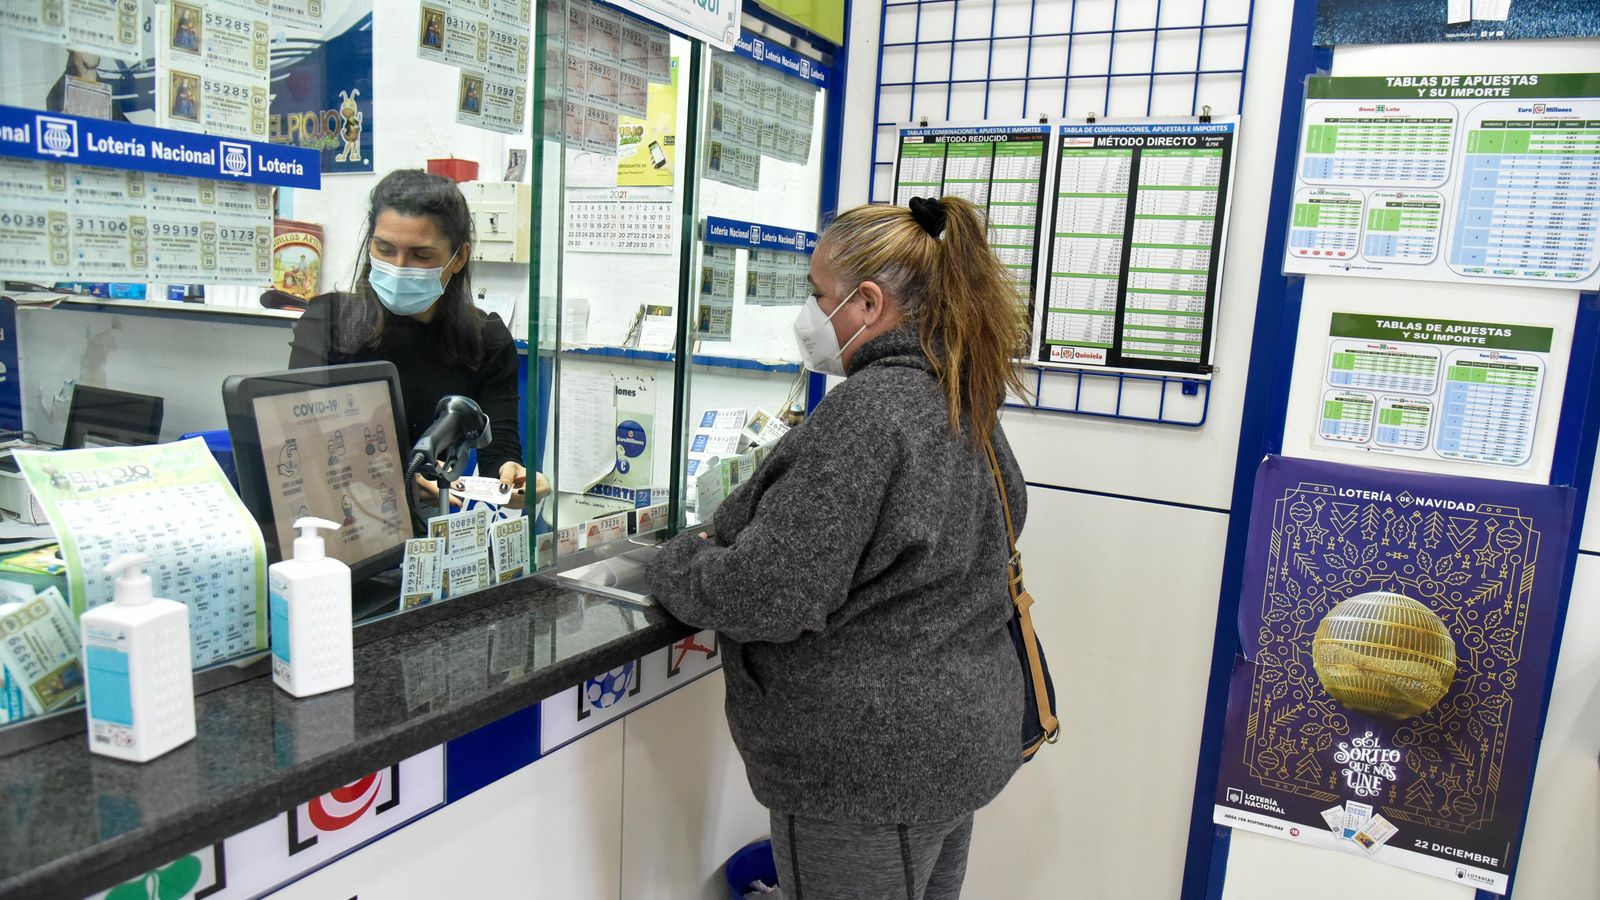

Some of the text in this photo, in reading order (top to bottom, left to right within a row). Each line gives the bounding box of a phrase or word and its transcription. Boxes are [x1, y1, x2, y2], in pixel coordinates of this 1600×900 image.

[206, 12, 250, 33] 55285
[446, 16, 476, 32] 03176
[591, 18, 613, 32] 24630
[490, 30, 518, 46] 71992
[766, 49, 799, 71] Lotería Nacional
[589, 64, 611, 76] 24630
[1386, 75, 1538, 86] TABLAS DE APUESTAS
[204, 80, 248, 98] 55285
[485, 83, 514, 96] 71992
[1417, 88, 1510, 97] Y SU IMPORTE
[588, 110, 608, 120] 24630
[288, 109, 341, 140] PIOJO
[0, 124, 30, 144] nal
[936, 134, 967, 142] MÉTODO
[1097, 135, 1196, 146] MÉTODO DIRECTO
[87, 132, 216, 165] Lotería Nacional
[258, 155, 304, 176] Lotería
[1, 213, 46, 228] 6039
[76, 218, 128, 232] 31106
[153, 223, 198, 237] 99919
[710, 224, 749, 239] Lotería Nacional
[762, 232, 795, 245] Lotería Nacional
[1376, 320, 1512, 337] TABLAS DE APUESTAS
[1433, 334, 1486, 344] IMPORTE
[293, 400, 338, 418] COVID-19
[1339, 487, 1392, 502] LOTERÍA
[1416, 497, 1476, 512] NAVIDAD
[450, 516, 476, 529] 00898
[451, 564, 476, 578] 00898
[1352, 731, 1380, 748] EL
[1334, 742, 1400, 765] SORTEO
[1349, 761, 1396, 781] QUE NOS
[1342, 769, 1383, 796] UNE
[1244, 800, 1286, 814] NACIONAL
[1245, 793, 1278, 806] LOTERÍA
[1414, 839, 1499, 866] 22 DICIEMBRE
